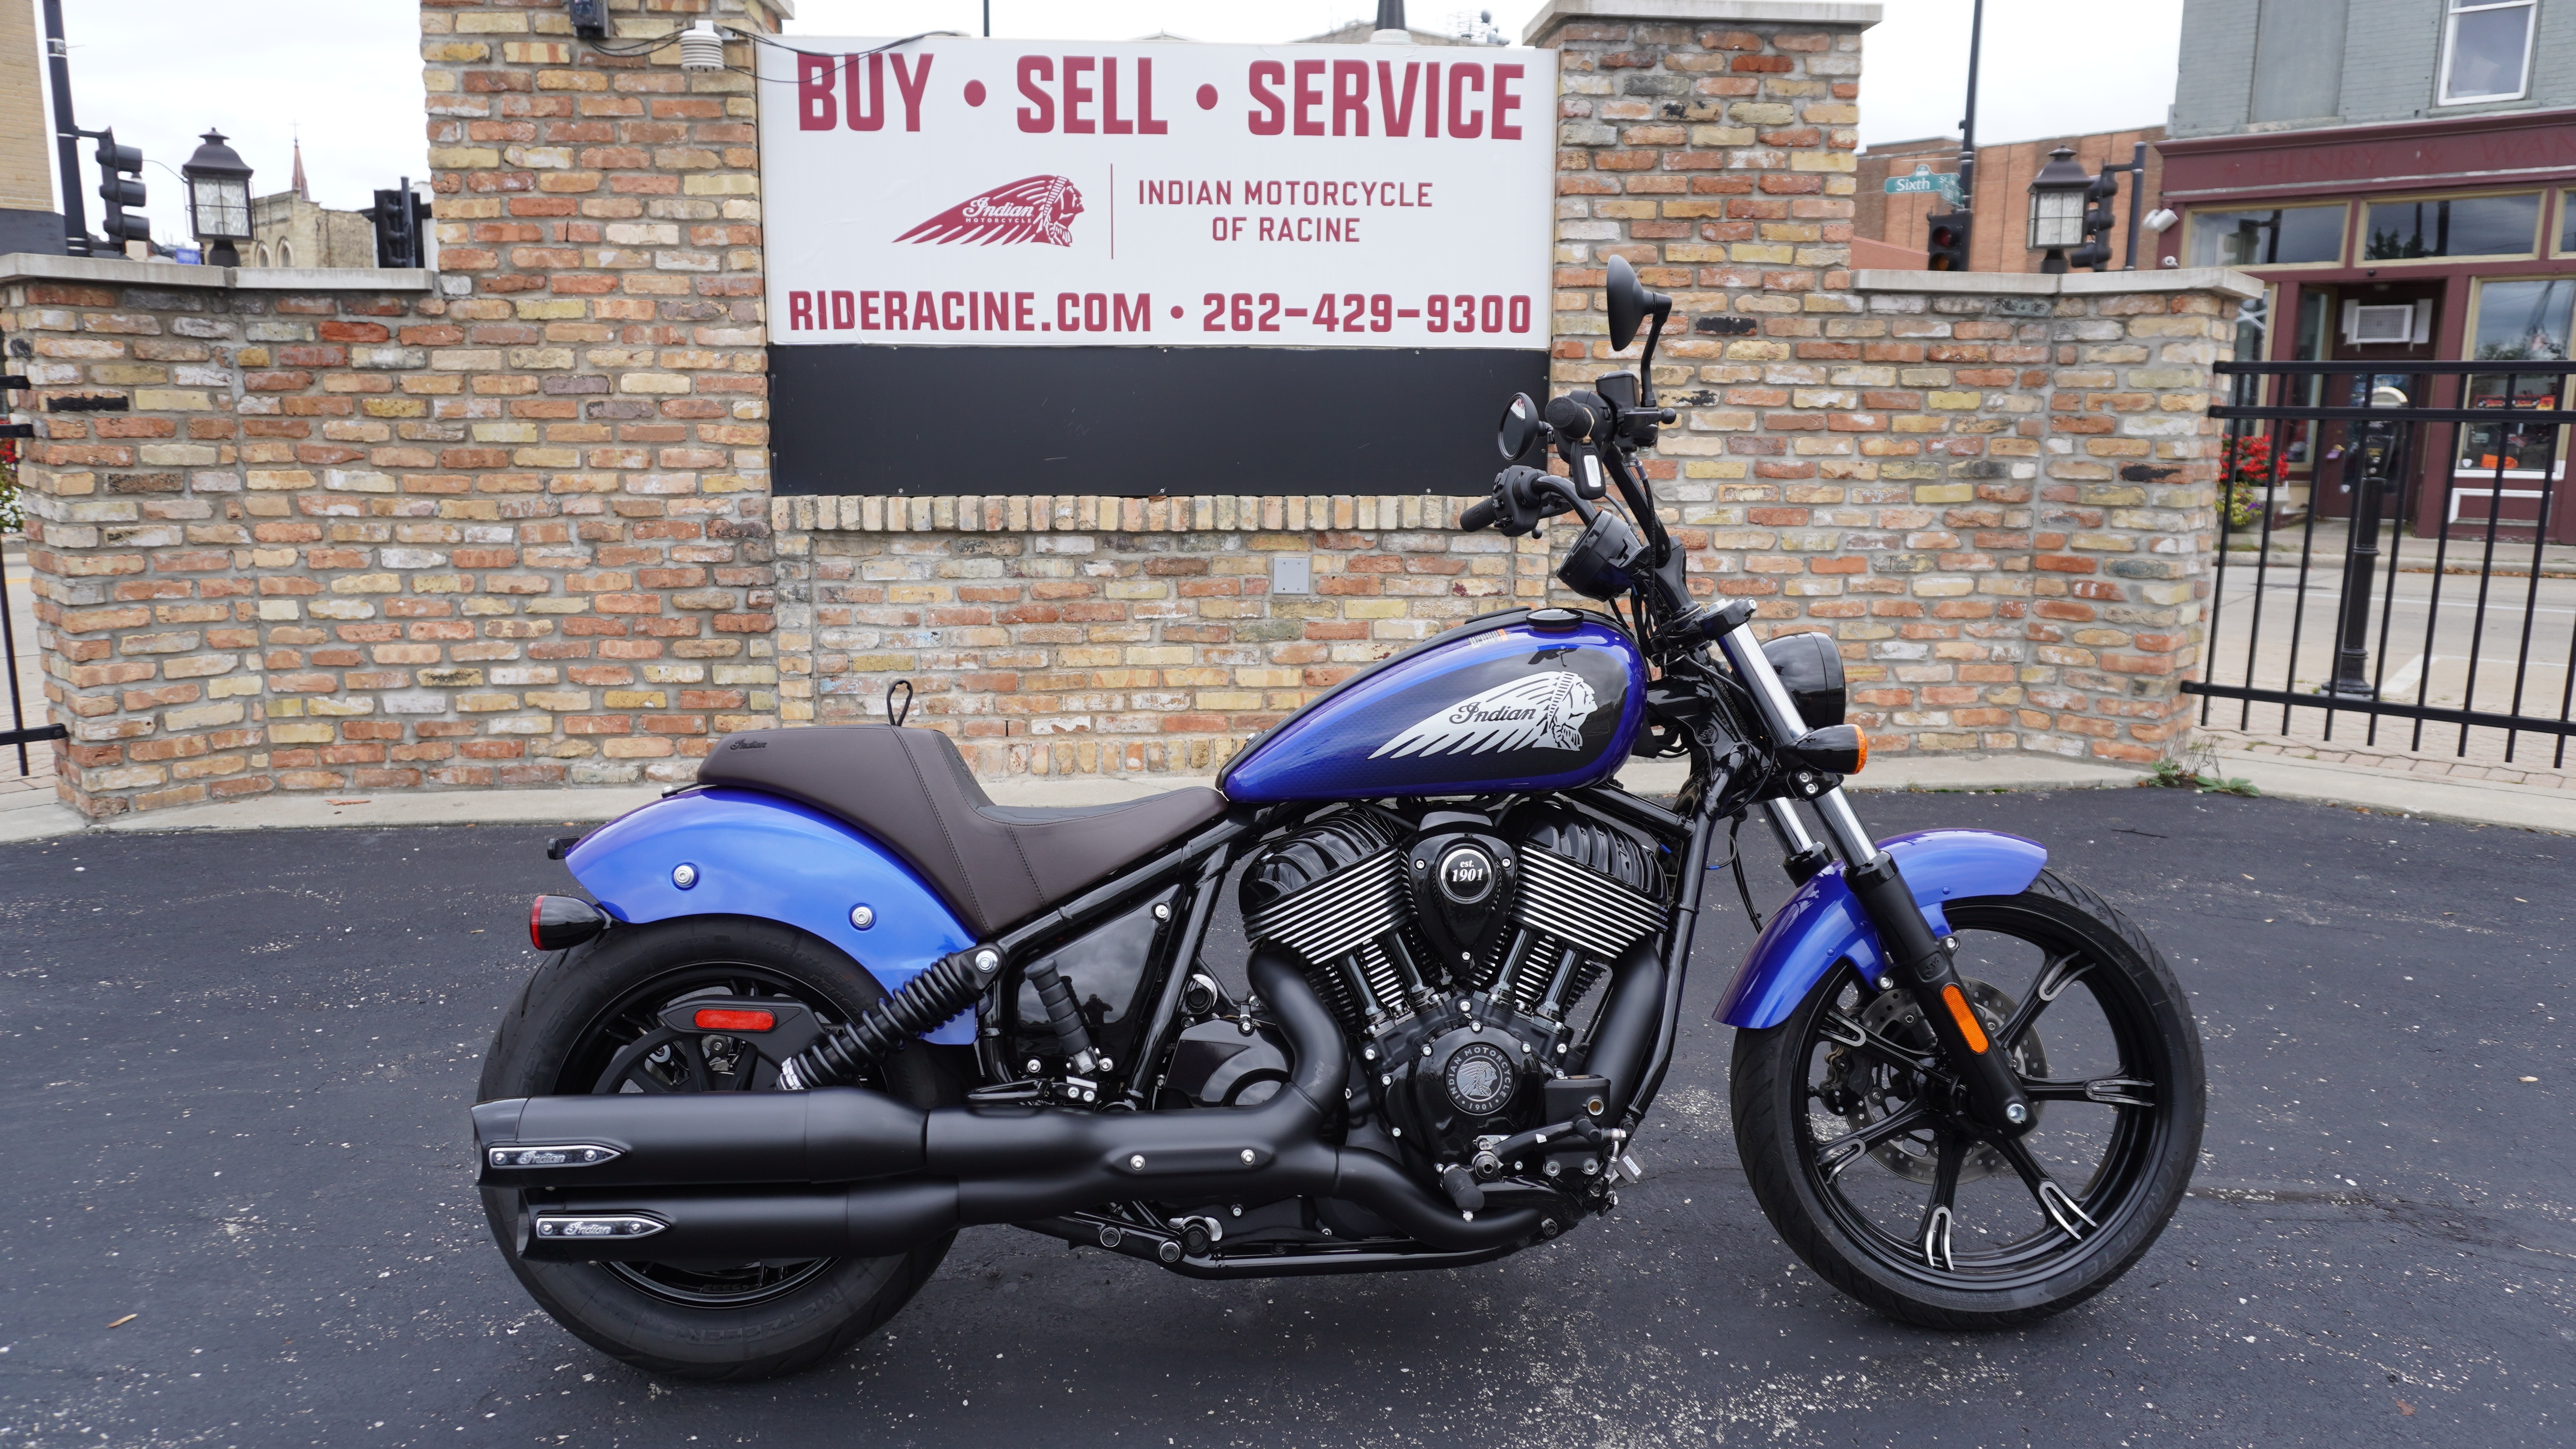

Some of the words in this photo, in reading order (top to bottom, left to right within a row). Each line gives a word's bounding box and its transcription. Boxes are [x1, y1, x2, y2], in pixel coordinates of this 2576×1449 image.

[798, 53, 933, 132] BUY
[1017, 56, 1167, 135] SELL
[1249, 60, 1524, 140] SERVICE
[1139, 181, 1231, 205] INDIAN
[1245, 181, 1432, 207] MOTORCYCLE
[1896, 177, 1930, 191] Sixth
[962, 197, 1034, 217] Indian
[1213, 217, 1246, 241] OF
[1260, 217, 1359, 242] RACINE
[789, 291, 1150, 332] RIDERACINE.COM
[1203, 293, 1531, 333] 262-429-9300
[1449, 701, 1537, 724] Indian
[730, 739, 767, 750] Indian
[1460, 859, 1474, 867] est.
[1451, 868, 1483, 882] 1901
[1448, 1056, 1462, 1100] INDIAN
[1464, 1046, 1511, 1098] MOTORCYCLE
[1469, 1102, 1493, 1111] 1901
[517, 1150, 566, 1165] Indian
[562, 1221, 612, 1236] Indian
[687, 1287, 844, 1346] METZELER
